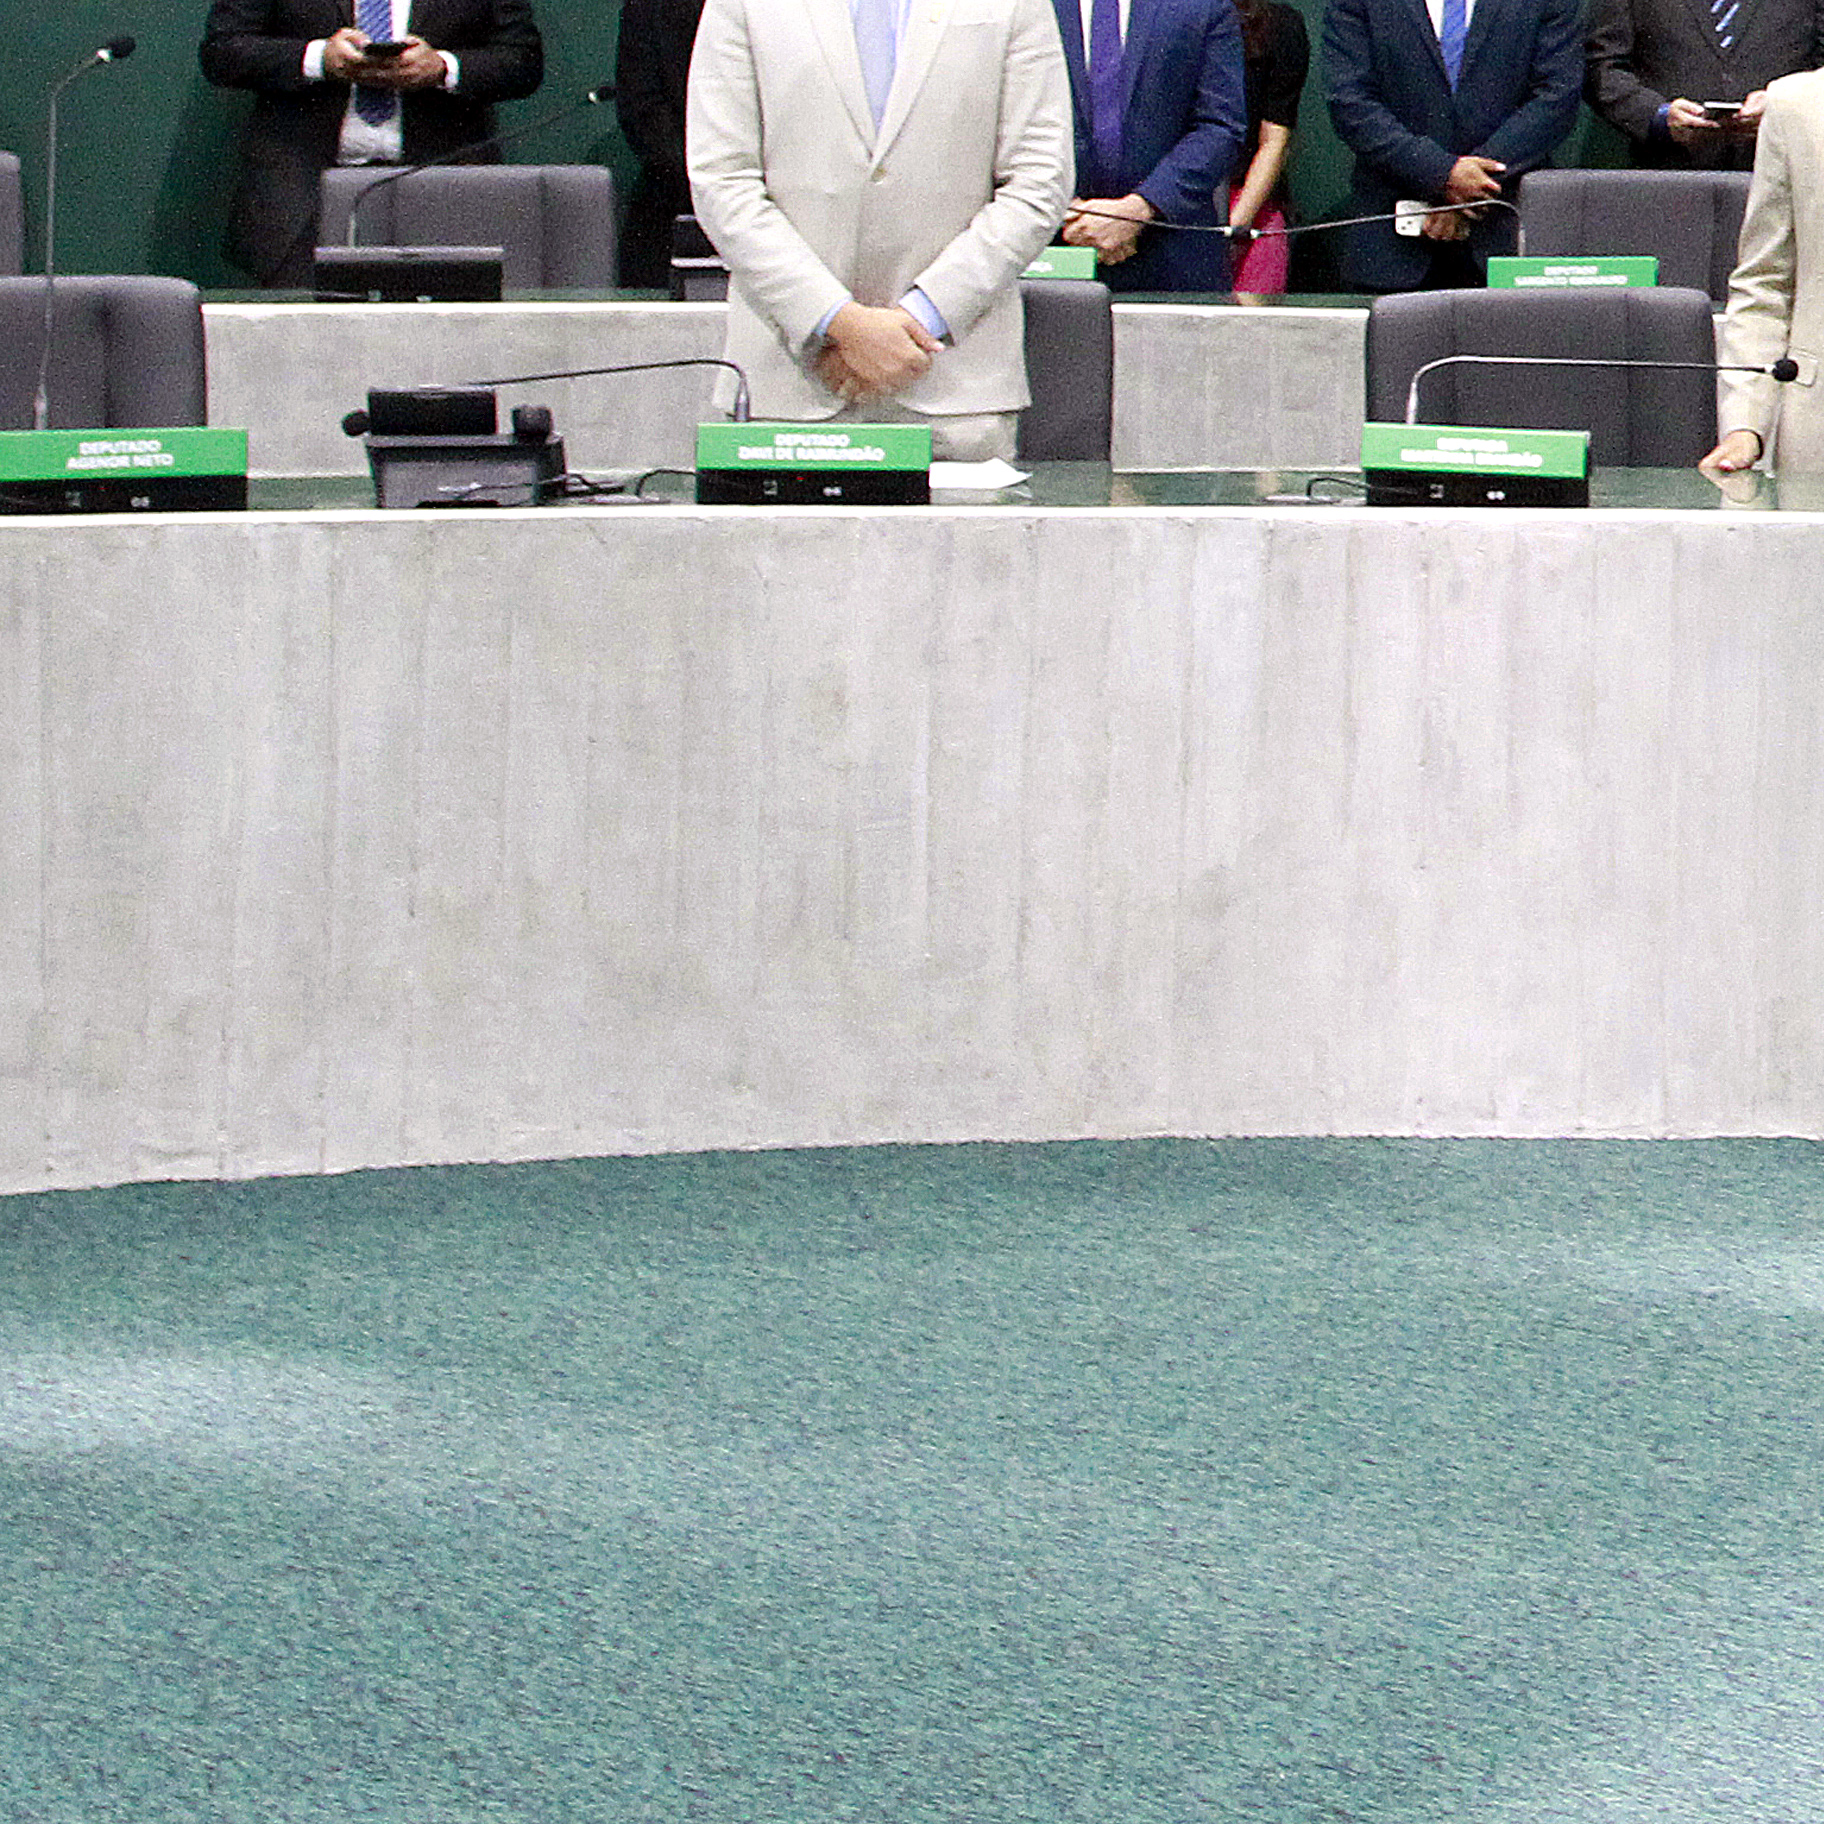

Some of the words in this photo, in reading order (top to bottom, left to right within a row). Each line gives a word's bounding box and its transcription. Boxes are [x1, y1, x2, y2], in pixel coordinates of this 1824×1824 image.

[78, 439, 162, 455] DEPUTADO
[773, 433, 851, 447] DEPUTADO
[737, 446, 774, 460] DAVI
[774, 447, 795, 461] DE
[66, 454, 130, 470] AGENOR
[132, 453, 174, 467] NETO
